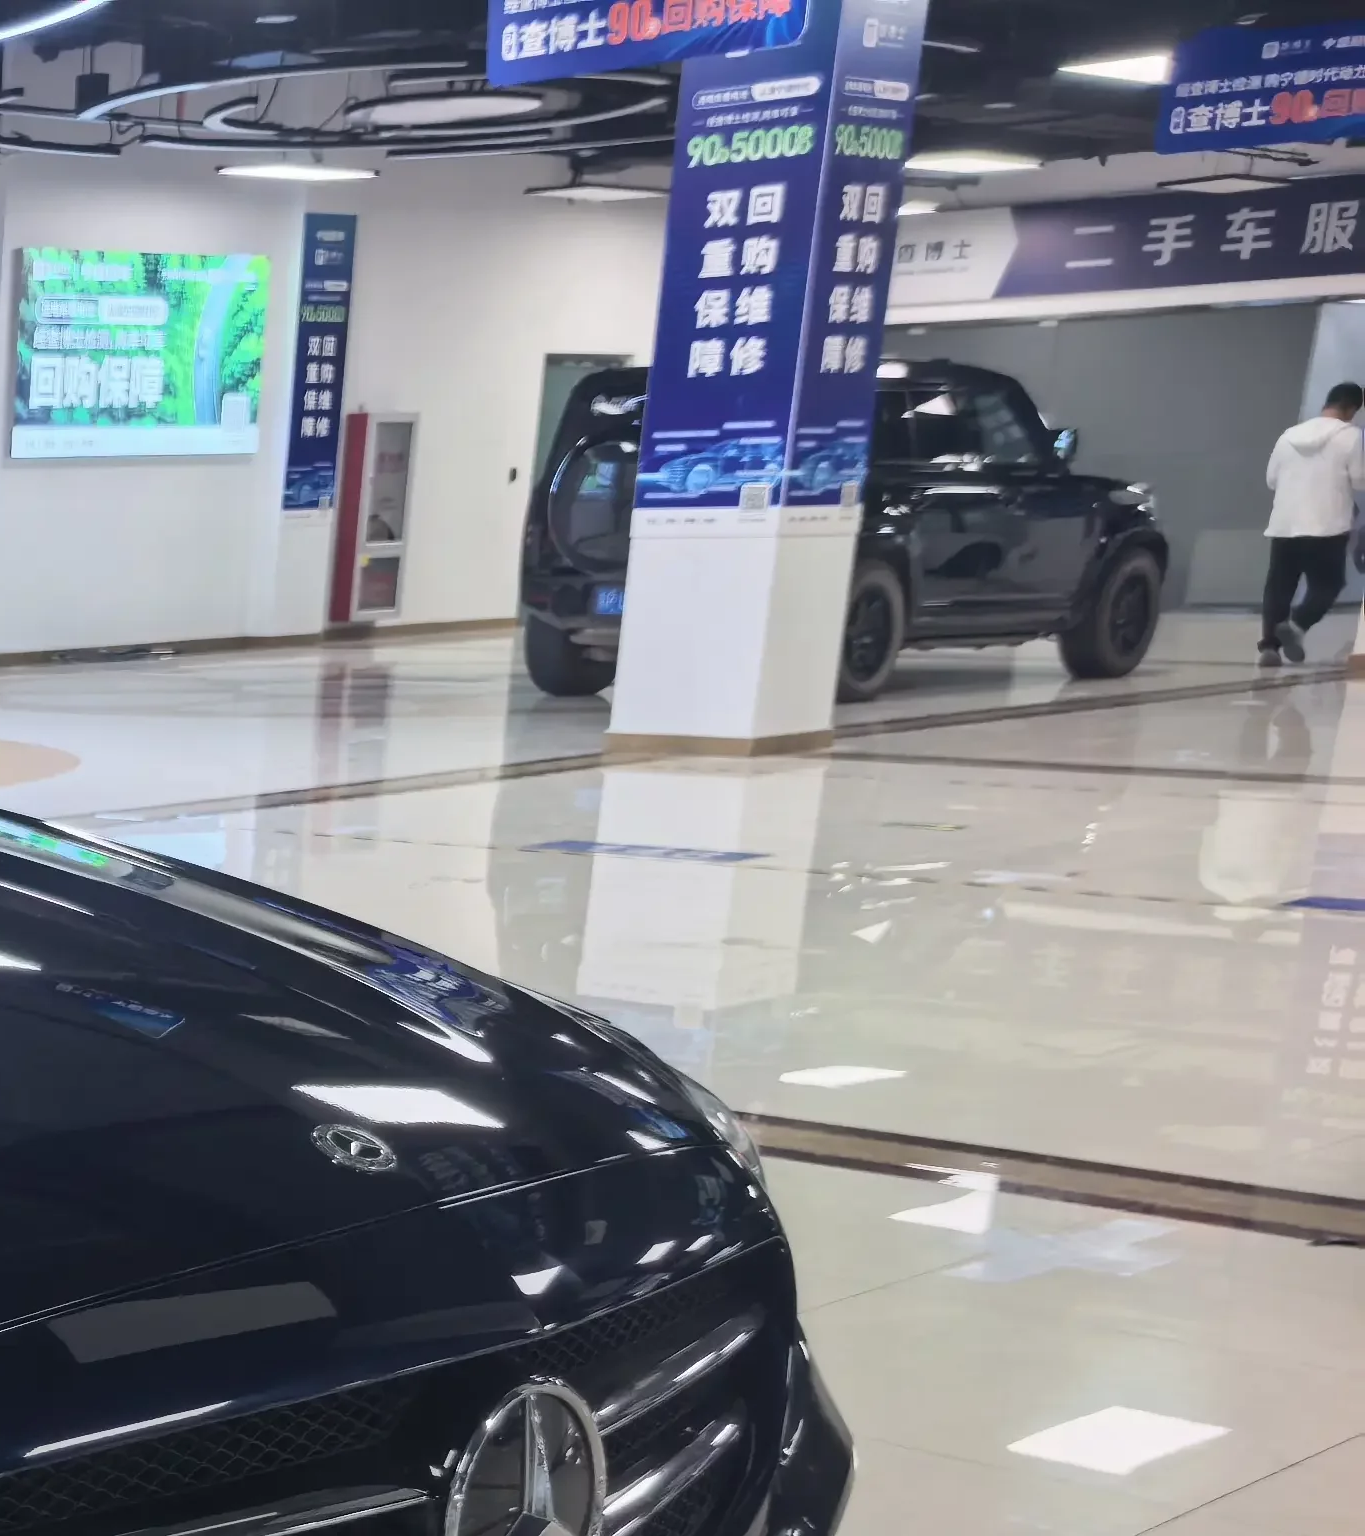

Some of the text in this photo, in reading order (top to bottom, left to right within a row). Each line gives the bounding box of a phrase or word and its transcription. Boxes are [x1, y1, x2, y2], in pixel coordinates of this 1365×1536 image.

[687, 188, 744, 379] 双重保障
[729, 181, 787, 377] 回购维修
[1065, 200, 1360, 268] 二手车服
[29, 354, 166, 410] 回购保障
